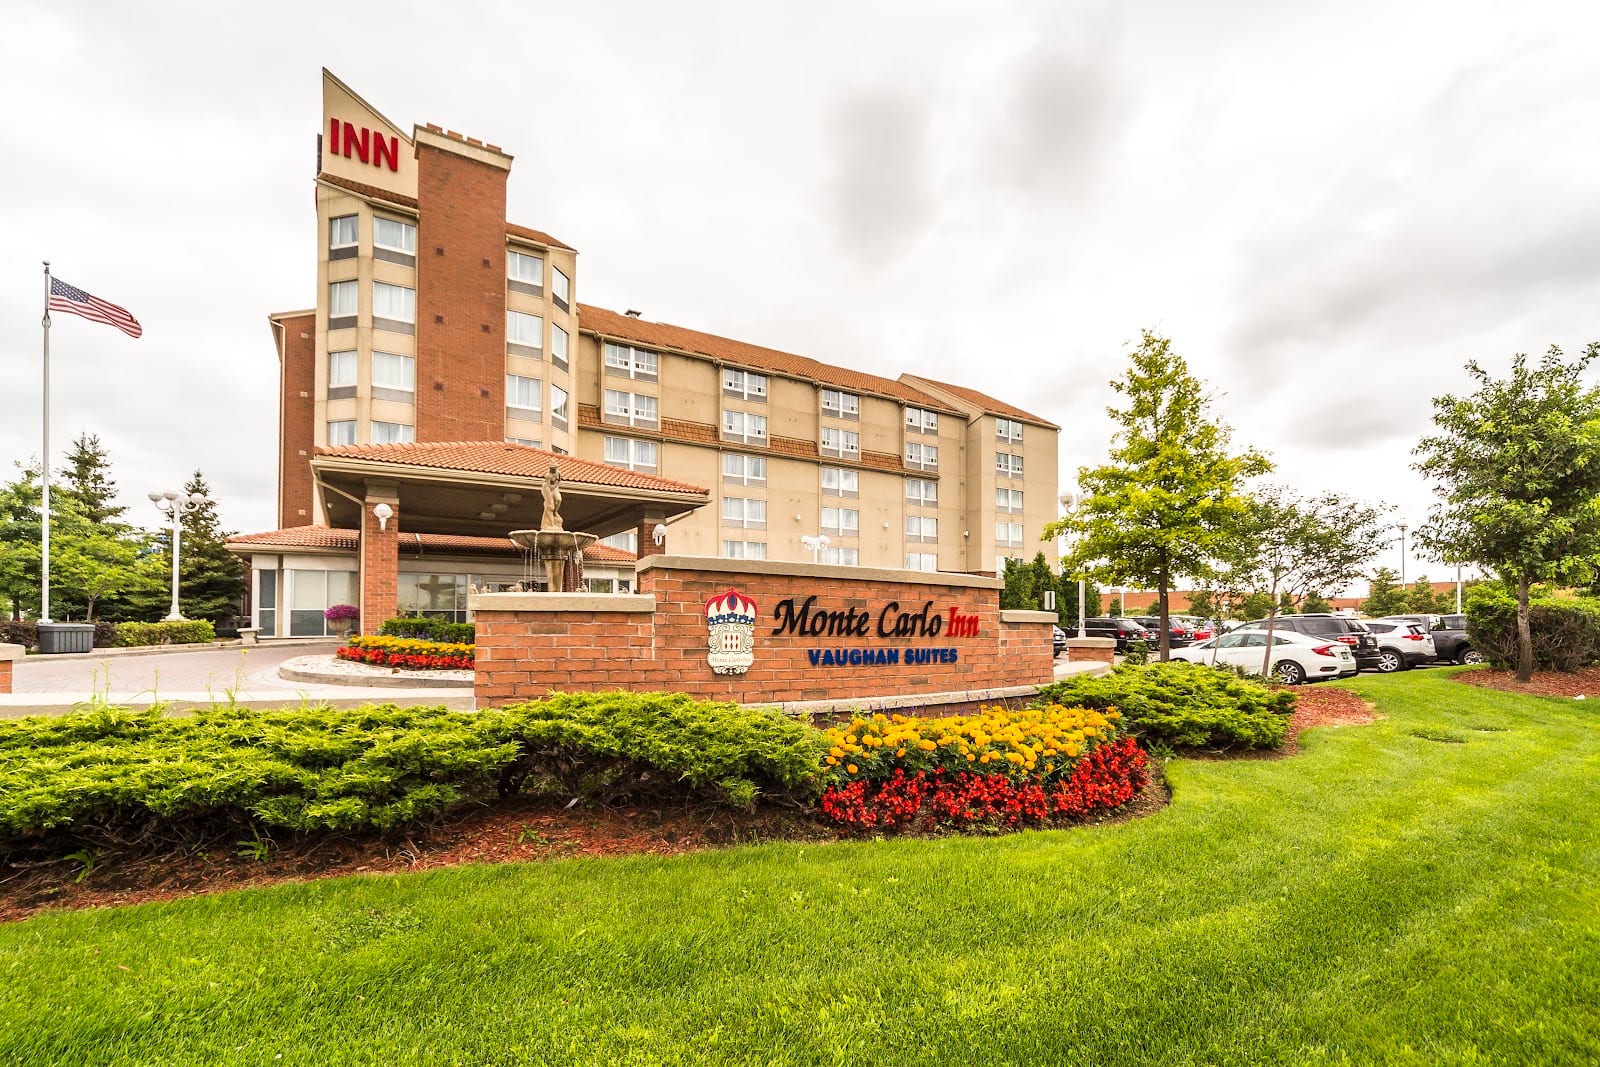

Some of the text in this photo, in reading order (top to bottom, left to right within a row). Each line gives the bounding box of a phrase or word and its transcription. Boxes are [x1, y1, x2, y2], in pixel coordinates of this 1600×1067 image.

[330, 117, 399, 172] INN
[772, 595, 980, 638] Monte Carlo Inn
[807, 648, 958, 666] VAUGHAN SUITES
